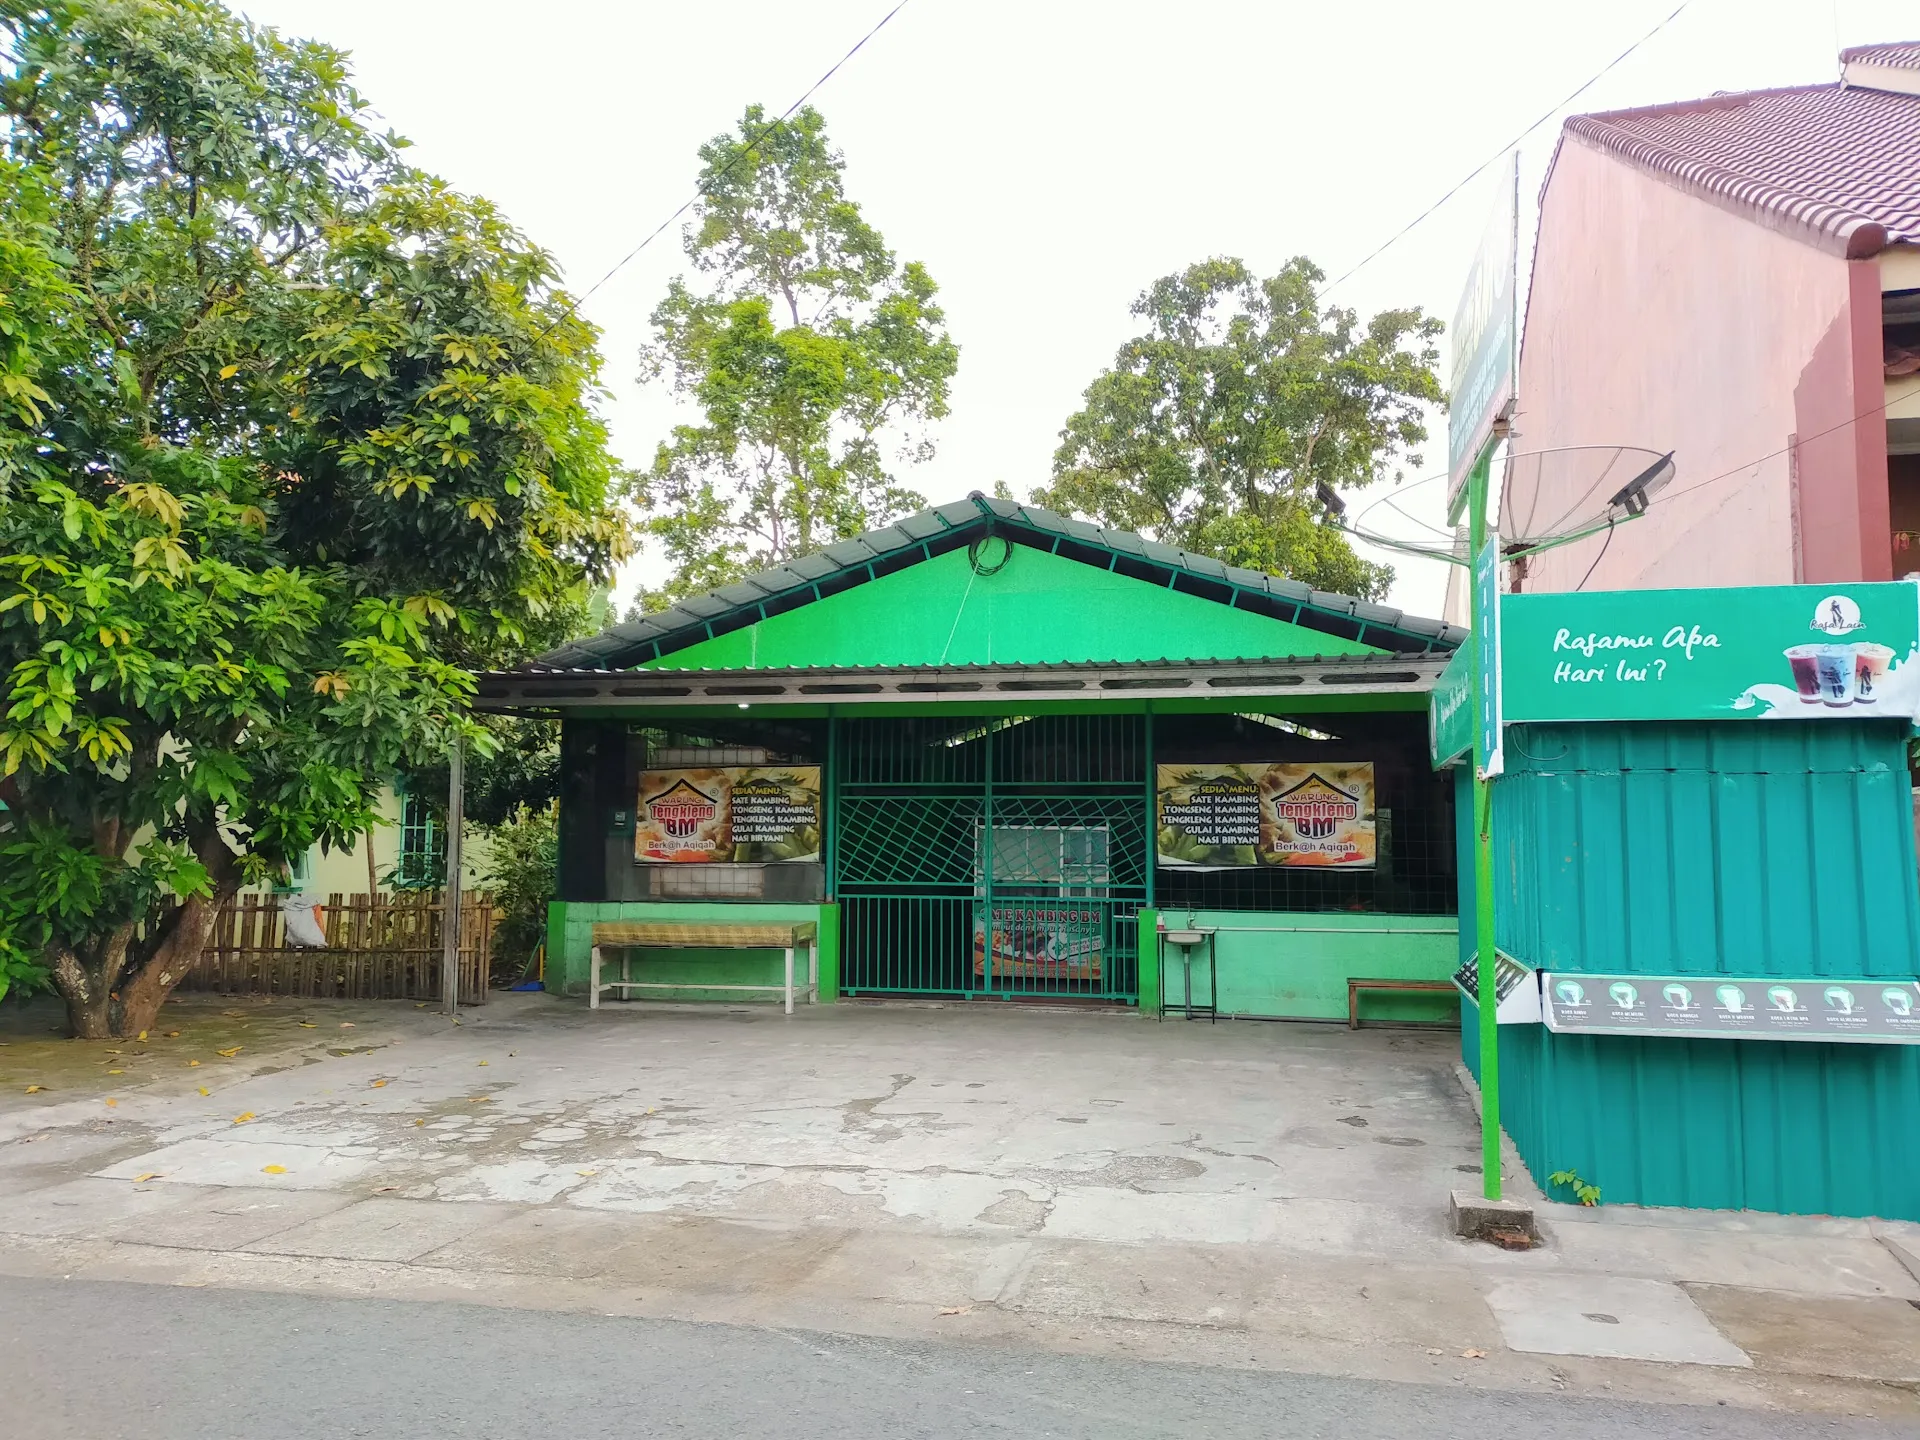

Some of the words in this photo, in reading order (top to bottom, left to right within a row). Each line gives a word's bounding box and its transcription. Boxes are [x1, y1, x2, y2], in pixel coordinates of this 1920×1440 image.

[1553, 628, 1653, 658] Rasamu
[1662, 625, 1722, 660] Apa
[1553, 660, 1608, 684] Hari
[731, 787, 753, 795] SEDIA
[1200, 785, 1225, 794] SEDIA
[1228, 785, 1259, 794] MENU:
[661, 796, 702, 804] WARUNG
[731, 796, 749, 805] SATE
[750, 796, 790, 805] KAMBING
[1191, 796, 1212, 804] SATE
[1214, 796, 1259, 804] KAMBING
[1289, 793, 1339, 801] WARUNG
[650, 805, 714, 820] Tengkleng
[731, 806, 773, 814] TONGSENG
[774, 806, 814, 814] KAMBING
[1164, 805, 1212, 814] TONGSENG
[1214, 805, 1259, 814] KAMBING
[1278, 802, 1354, 818] Tengkleng
[731, 815, 775, 824] TENGKLENG
[777, 815, 817, 824] KAMBING
[1161, 815, 1212, 824] TENGKLENG
[1214, 815, 1259, 824] KAMBING
[666, 819, 697, 837] BM
[731, 825, 753, 833] GULAI
[755, 825, 795, 833] KAMBING
[1185, 825, 1213, 834] GULAI
[1214, 825, 1259, 834] KAMBING
[1297, 818, 1333, 836] BM
[731, 834, 749, 843] NASI
[751, 834, 784, 843] BIRYANI
[1197, 835, 1219, 844] NASI
[1222, 835, 1260, 844] BIRYANI
[648, 841, 681, 851] Berk@h
[683, 841, 715, 851] Aqiqah
[1275, 842, 1316, 852] Berk@h
[1318, 842, 1355, 852] Aqiqah
[1080, 910, 1101, 923] BM
